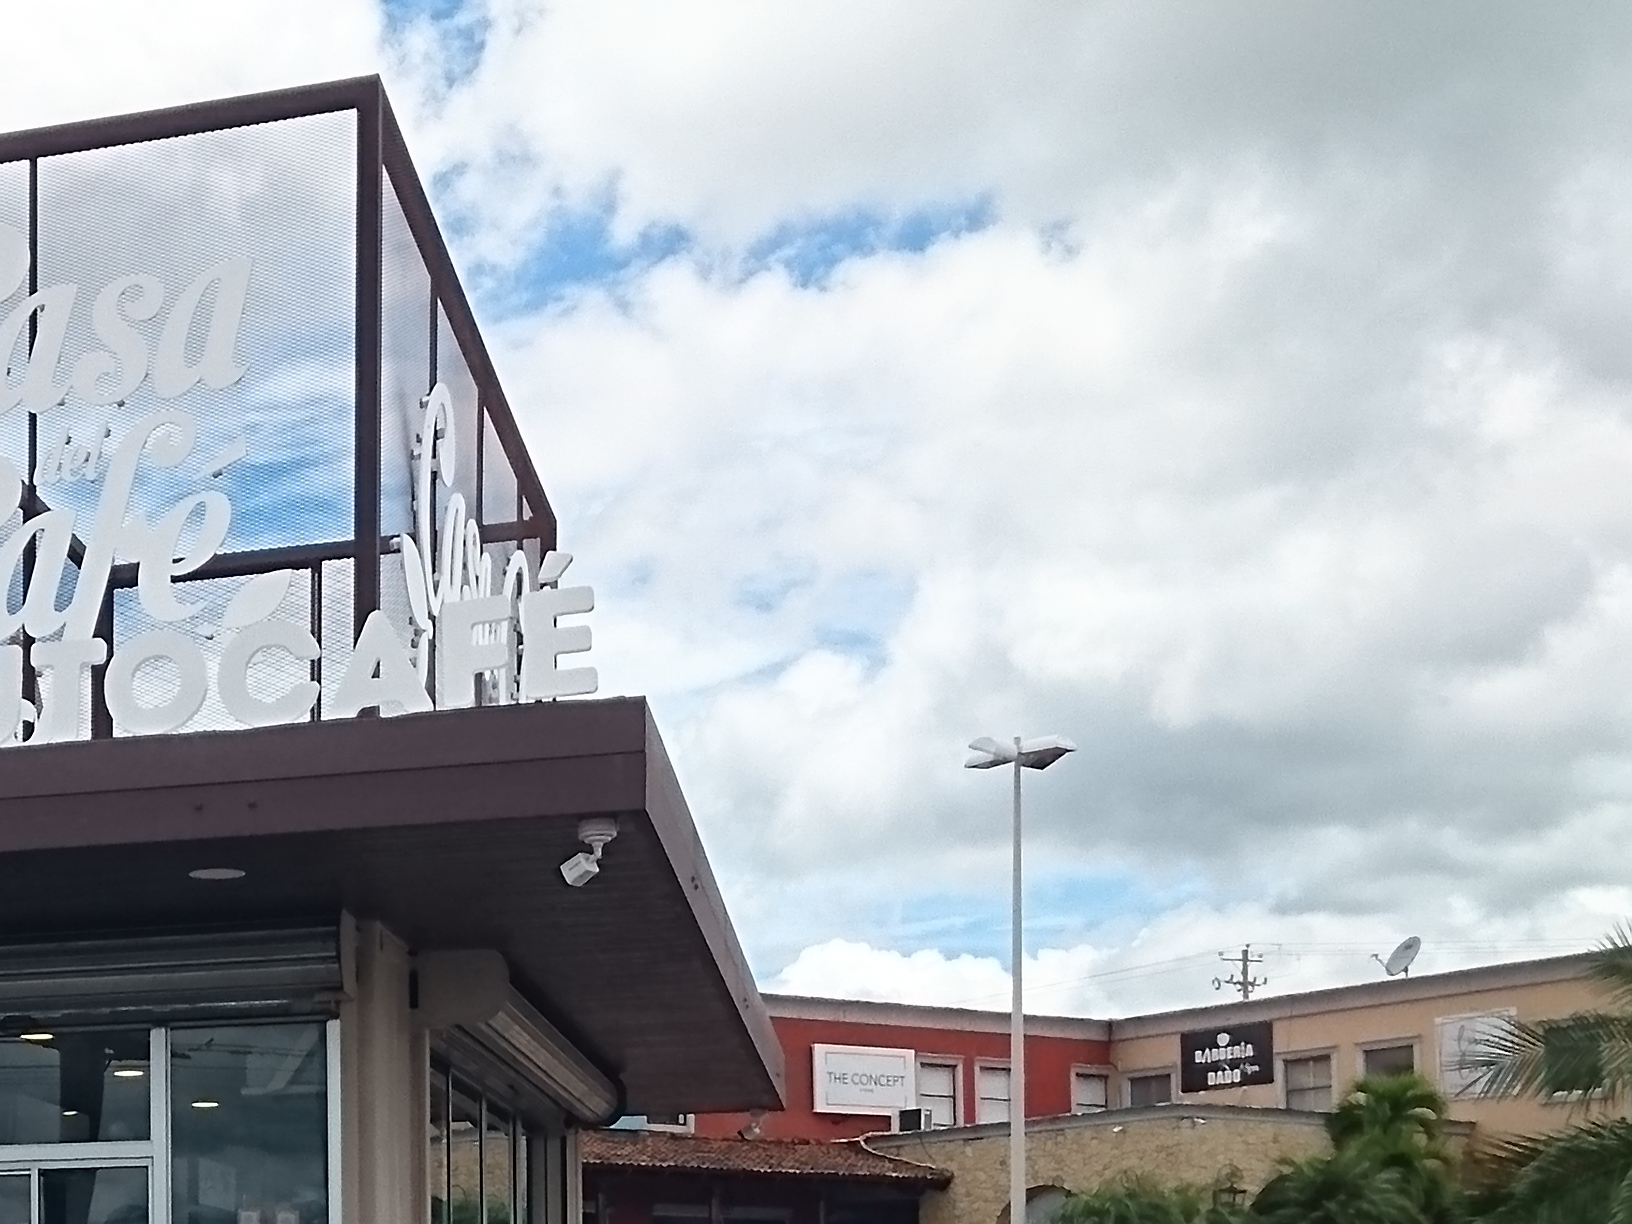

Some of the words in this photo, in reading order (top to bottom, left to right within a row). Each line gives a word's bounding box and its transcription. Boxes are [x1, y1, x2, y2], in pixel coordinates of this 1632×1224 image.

[33, 421, 112, 486] del
[827, 1072, 848, 1085] THE
[851, 1073, 905, 1087] CONCEPT
